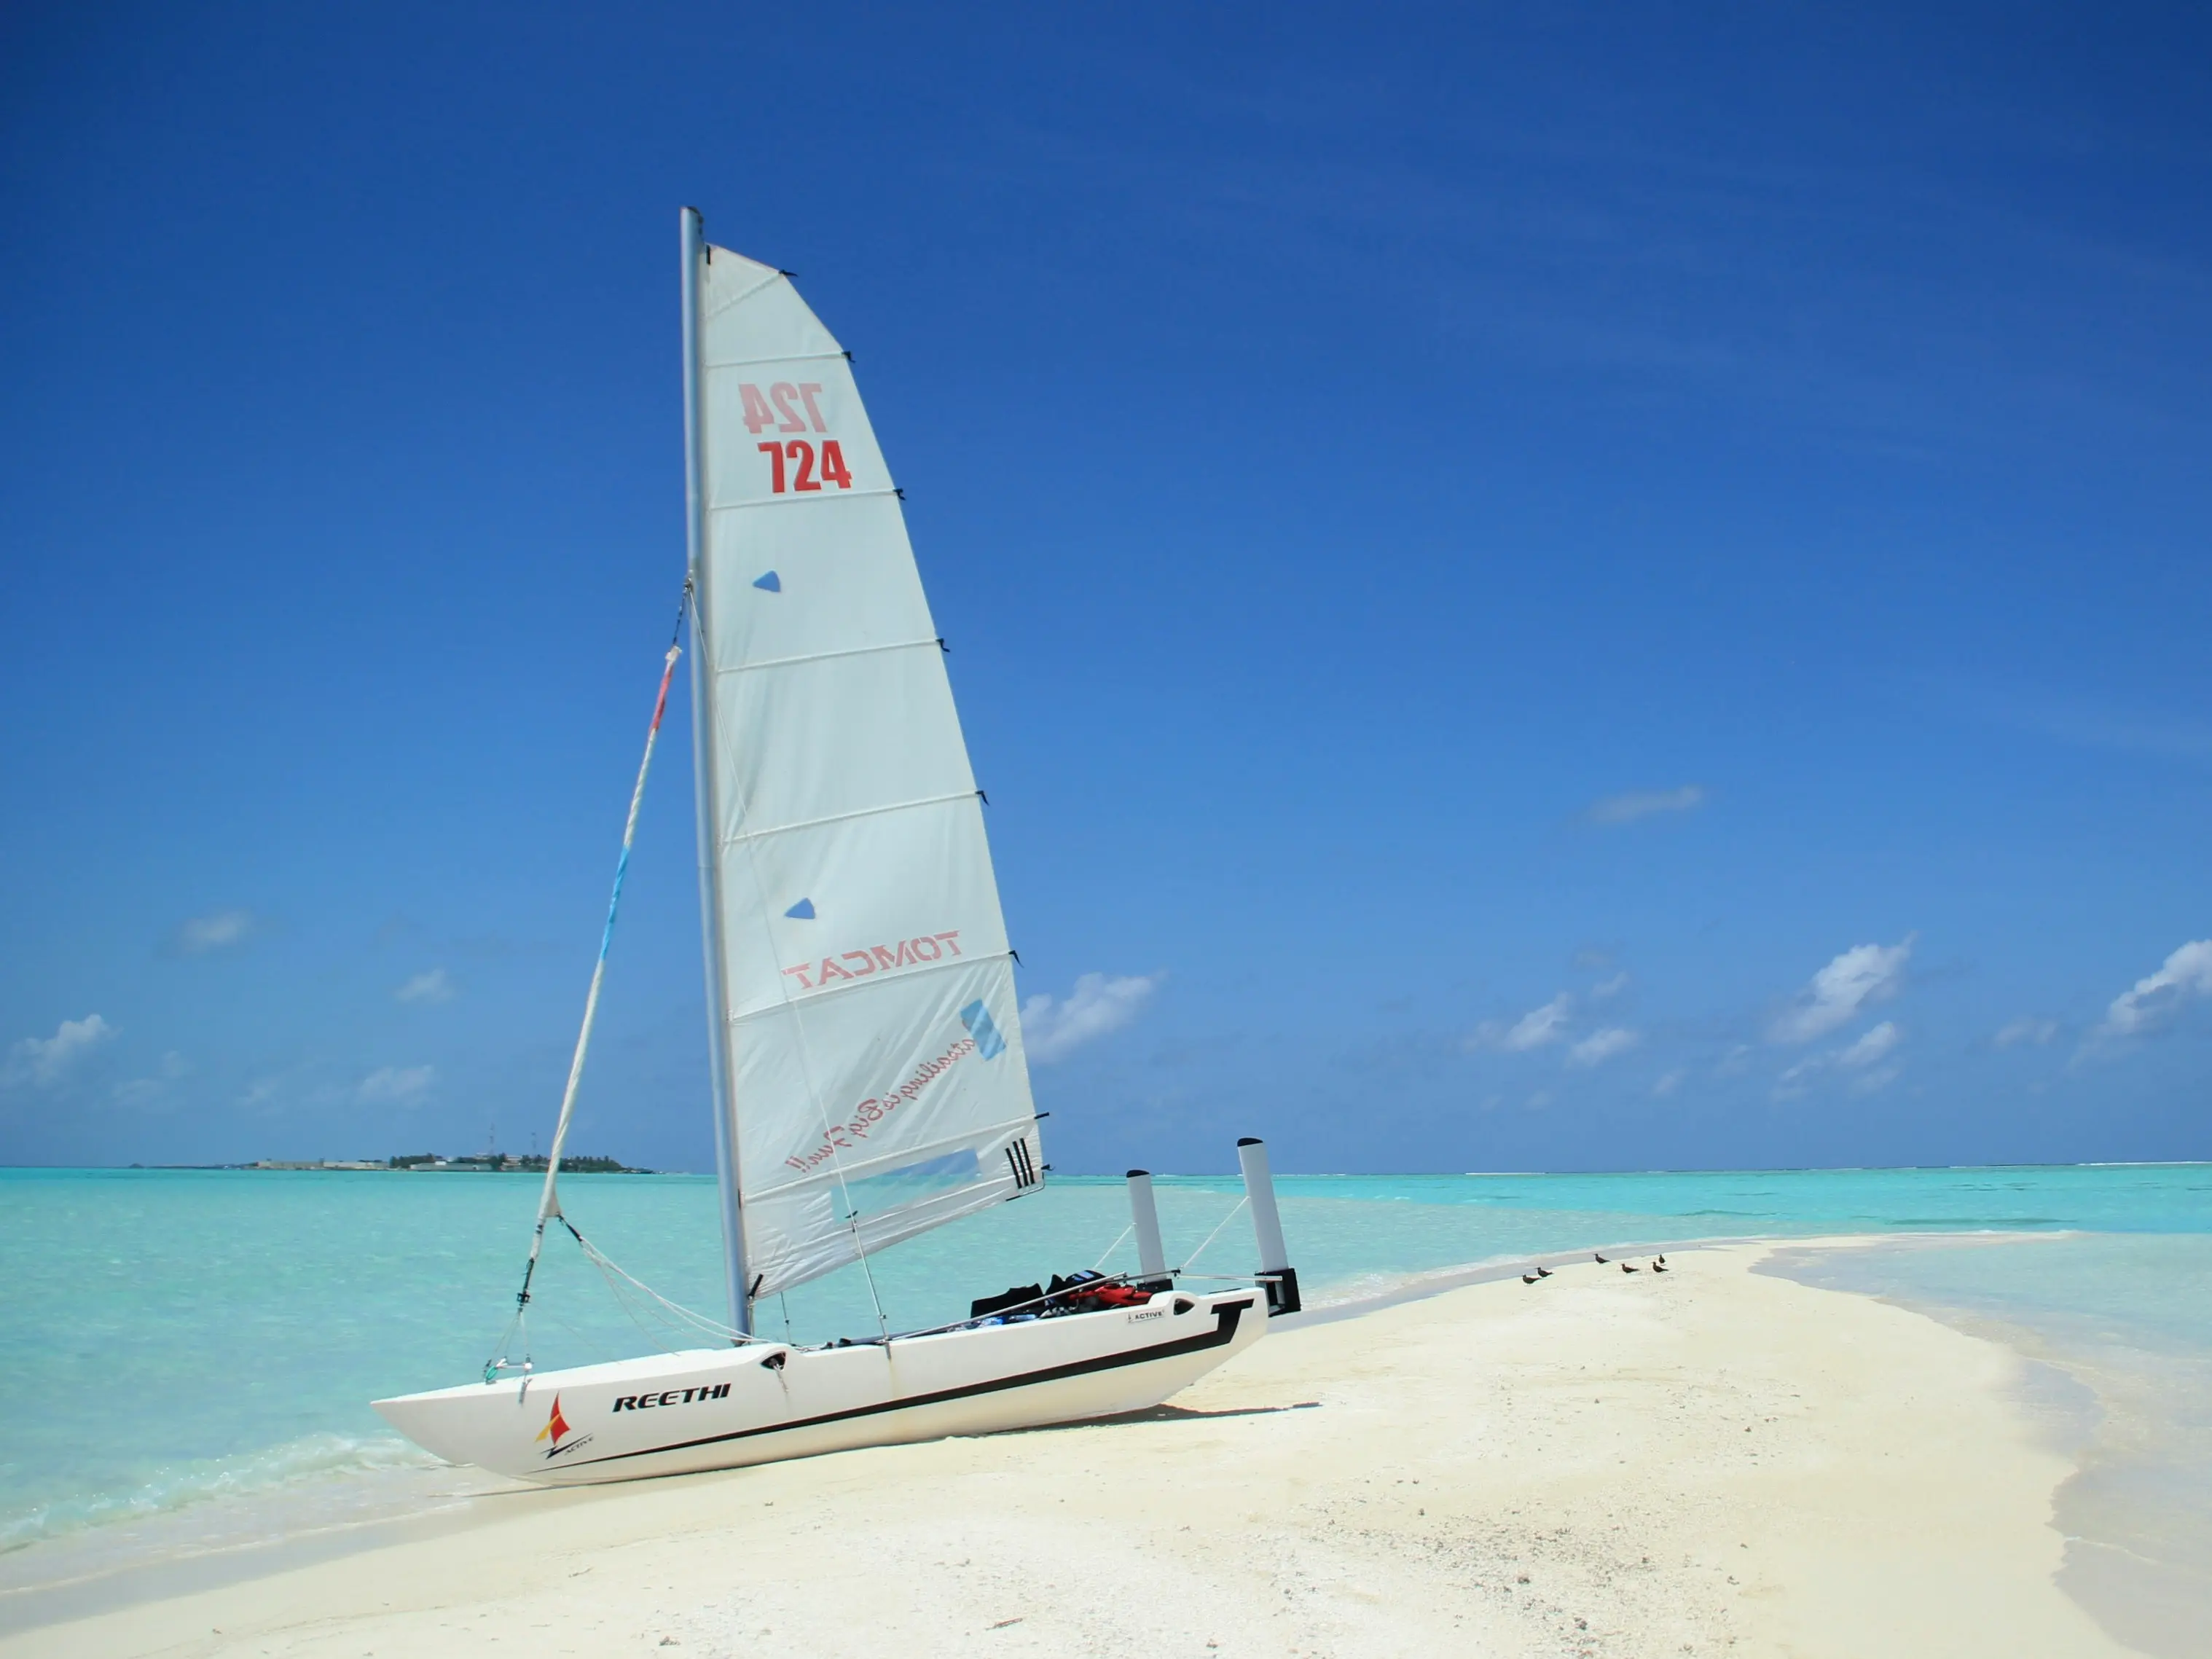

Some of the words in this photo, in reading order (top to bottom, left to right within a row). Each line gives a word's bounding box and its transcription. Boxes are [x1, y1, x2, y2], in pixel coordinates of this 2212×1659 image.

[758, 439, 852, 493] 724
[1134, 1312, 1163, 1320] ACTIVE
[613, 1383, 732, 1413] REETHI
